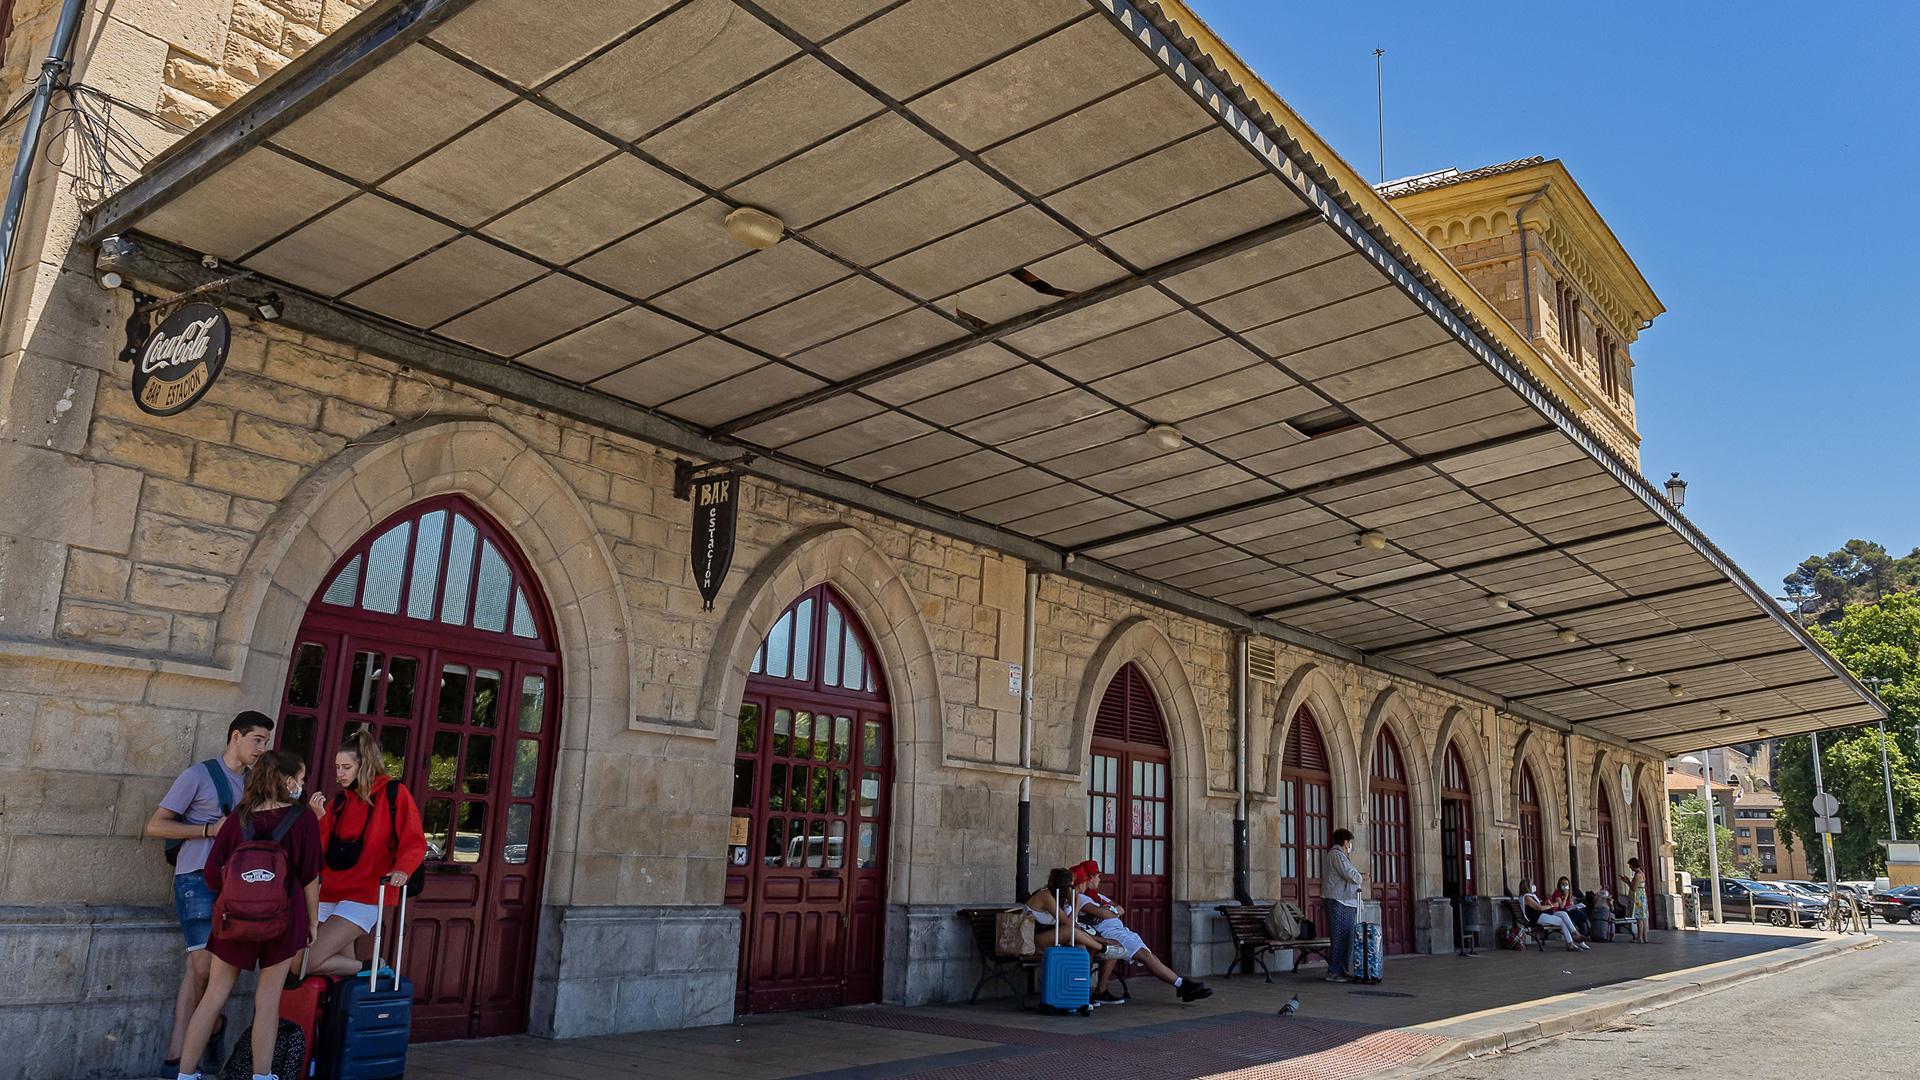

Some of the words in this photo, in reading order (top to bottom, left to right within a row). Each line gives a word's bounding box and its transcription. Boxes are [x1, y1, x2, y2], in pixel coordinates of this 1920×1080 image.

[146, 381, 162, 404] BAR
[165, 369, 201, 406] ESTACION
[700, 480, 730, 506] BAR
